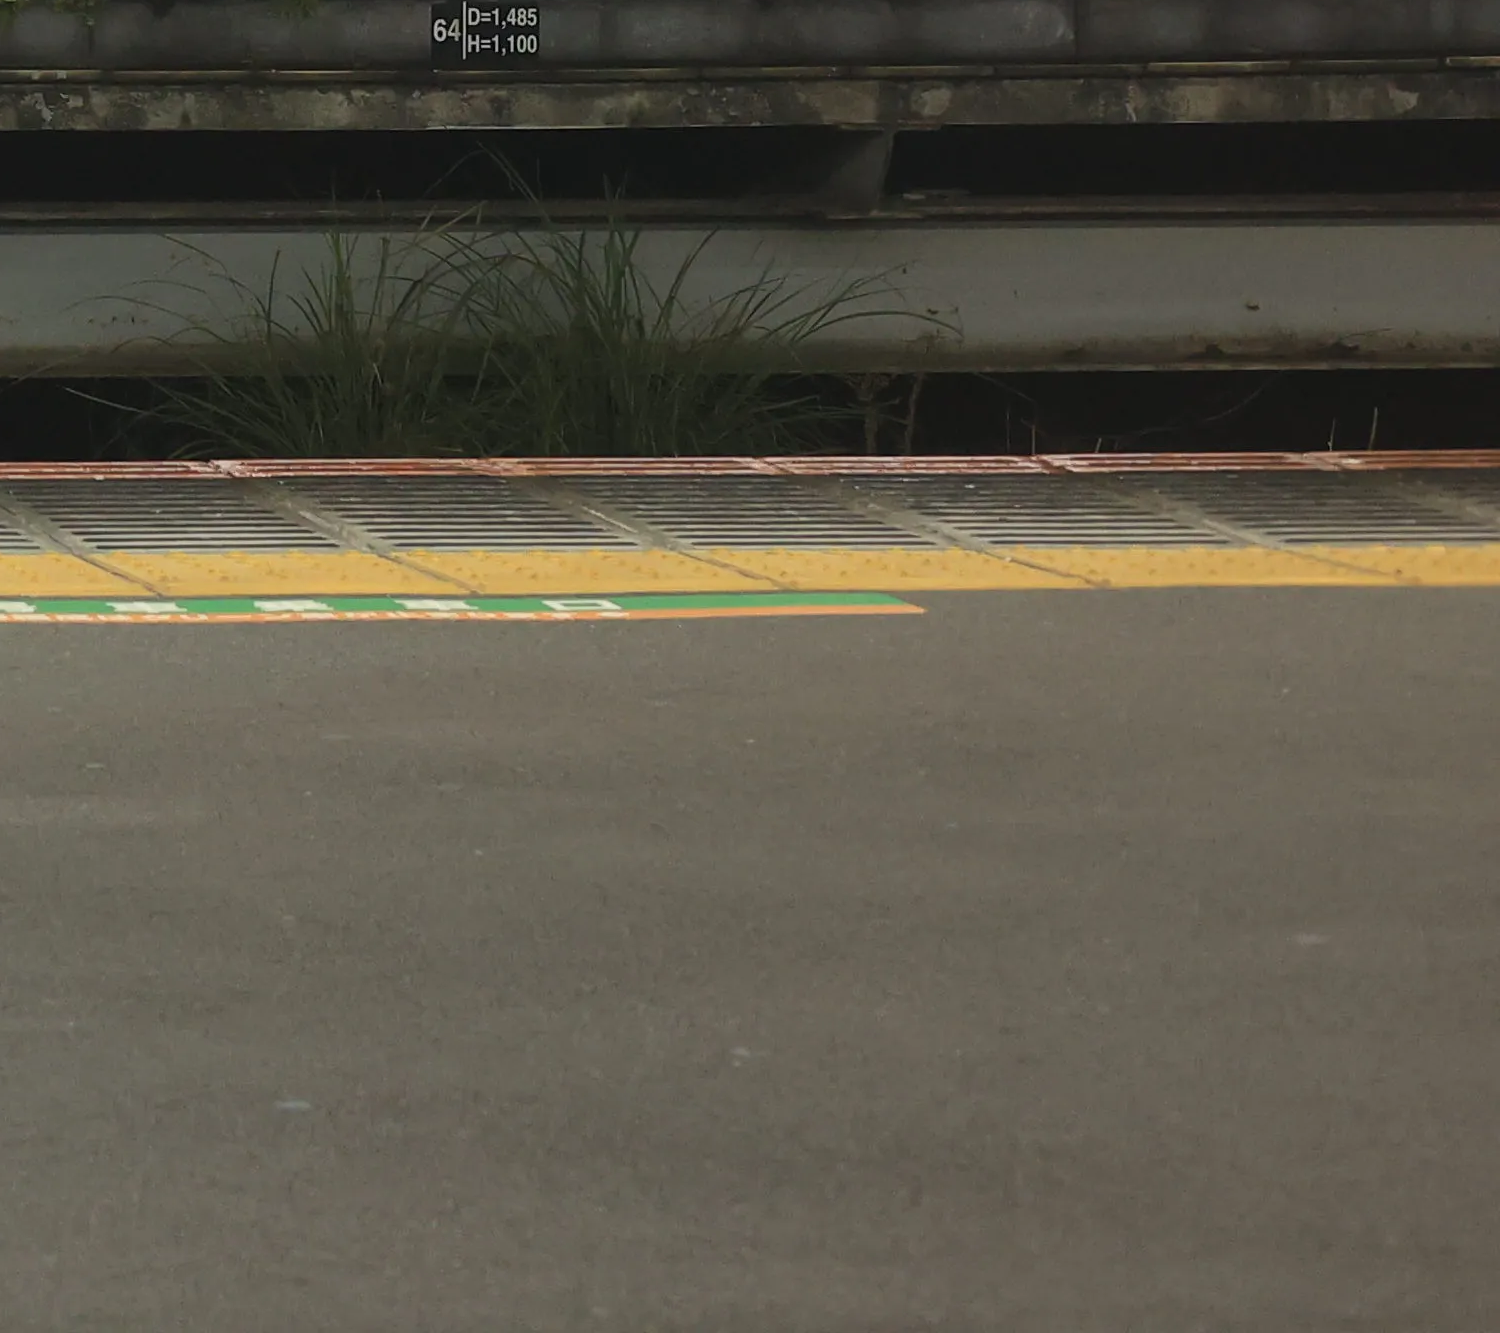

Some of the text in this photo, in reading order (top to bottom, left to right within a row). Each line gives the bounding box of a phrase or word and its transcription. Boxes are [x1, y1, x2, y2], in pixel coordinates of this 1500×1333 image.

[467, 7, 538, 29] D=1,485
[433, 18, 462, 42] 64
[467, 34, 538, 56] H=1,100
